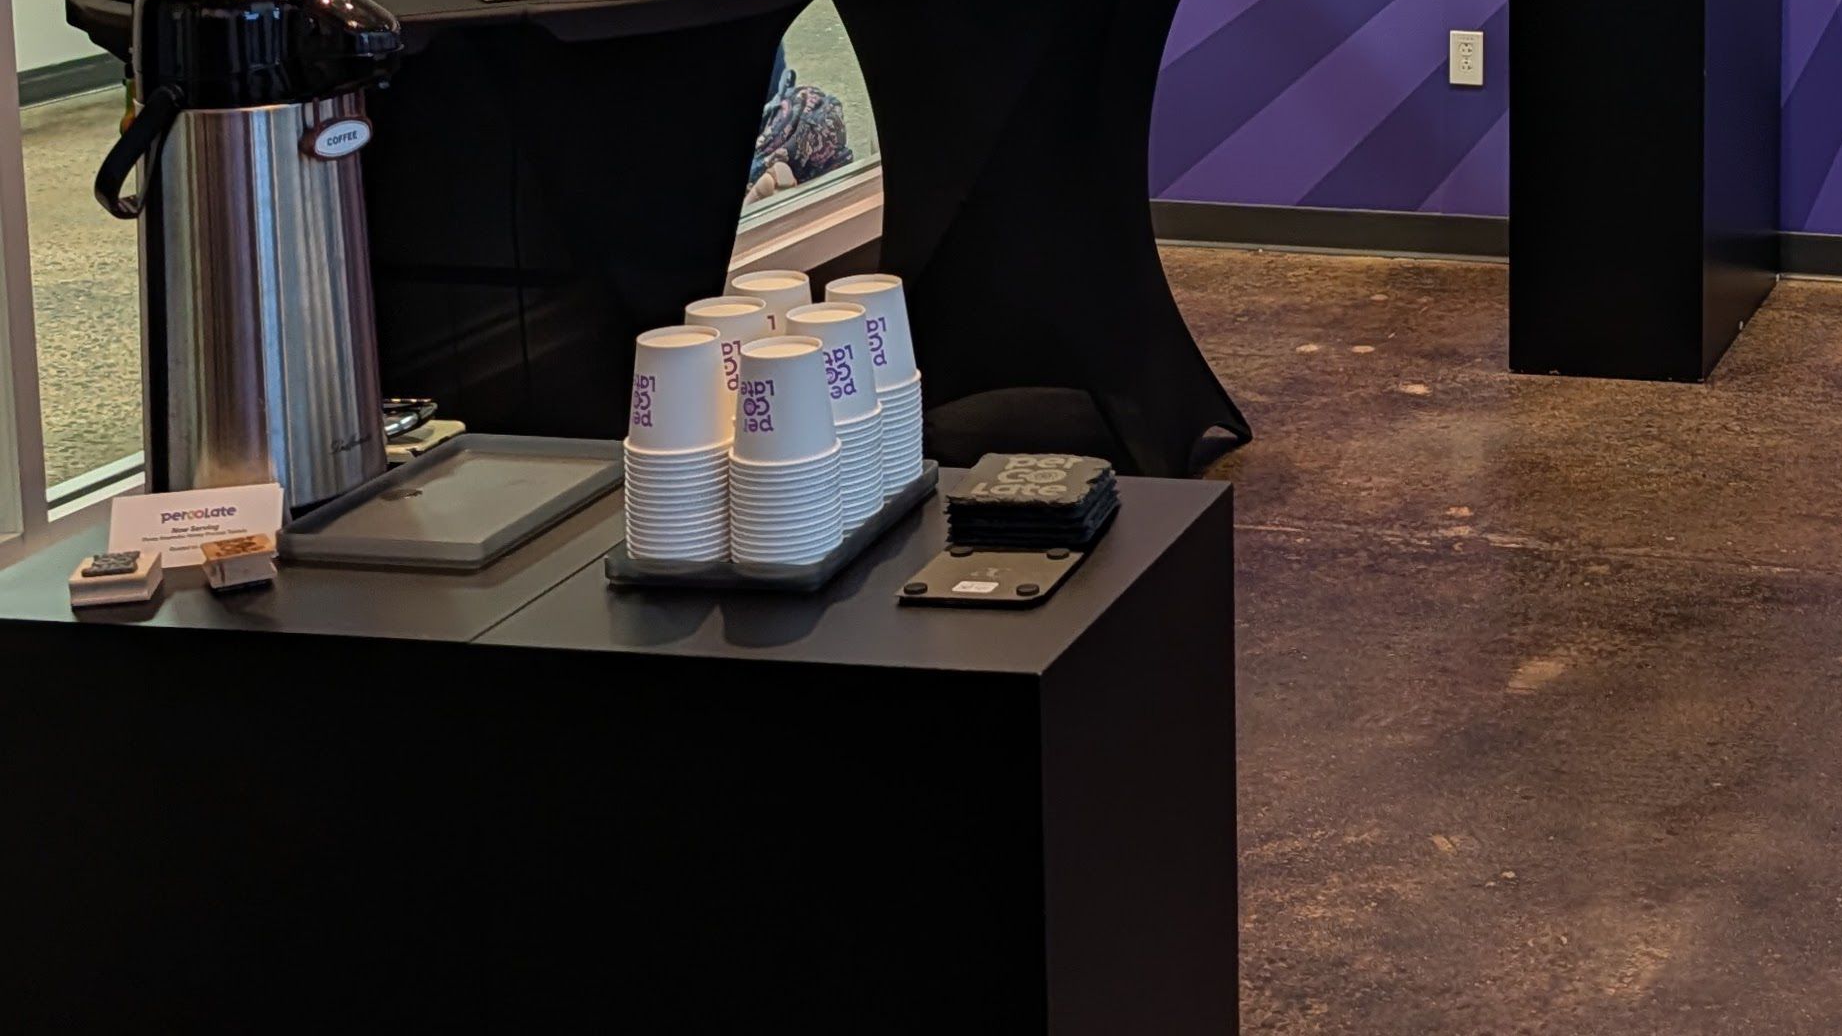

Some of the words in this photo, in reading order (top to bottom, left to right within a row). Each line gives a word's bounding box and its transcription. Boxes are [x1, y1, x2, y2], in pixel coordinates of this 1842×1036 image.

[326, 129, 358, 147] COFFEE
[1004, 457, 1083, 470] per
[190, 524, 220, 532] Serving
